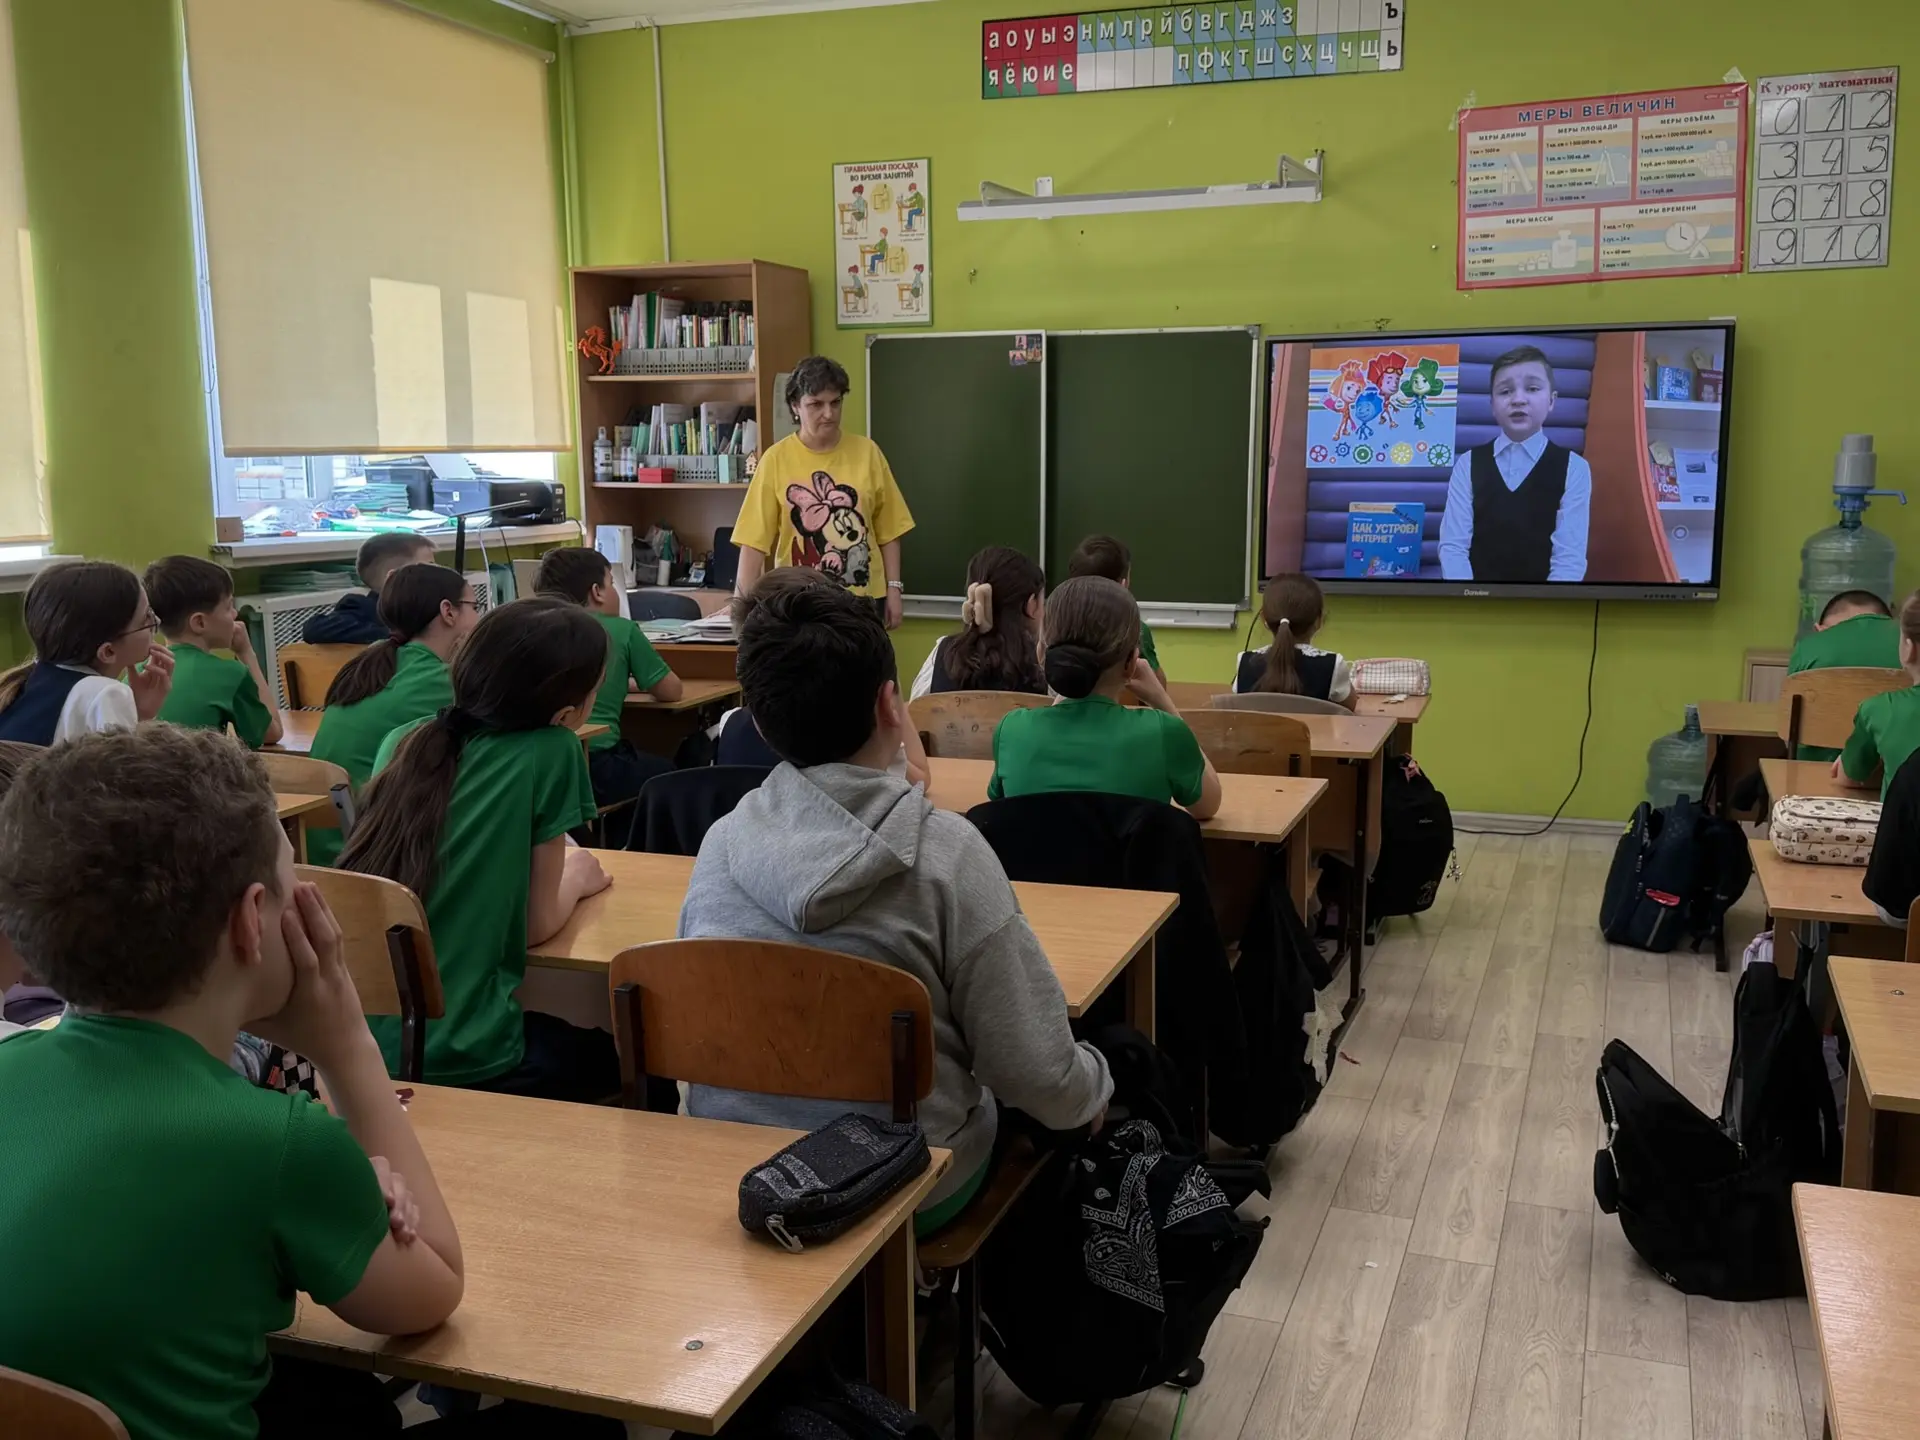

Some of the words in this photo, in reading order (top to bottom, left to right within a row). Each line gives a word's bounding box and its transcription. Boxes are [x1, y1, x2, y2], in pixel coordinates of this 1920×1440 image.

[1760, 82, 1772, 93] К
[1776, 82, 1814, 95] уроку
[1818, 76, 1893, 89] математики
[1518, 108, 1573, 122] МЕРЫ
[1582, 98, 1676, 116] ВЕЛИЧИН
[1775, 98, 1800, 135] 0
[1826, 94, 1845, 132] 1
[1867, 90, 1890, 128] 2
[1660, 117, 1682, 125] МЕРЫ
[1684, 114, 1715, 123] ОБЪЁМА
[1580, 123, 1618, 132] ПЛОЩАДИ
[1500, 132, 1527, 140] ДЛИНЫ
[1774, 142, 1798, 178] 3
[1822, 139, 1842, 174] 4
[1862, 136, 1887, 172] 5
[844, 164, 886, 173] ПРАВИЛЬНАЯ
[888, 162, 918, 170] ПОСАДКА
[883, 170, 914, 179] ЗАНЯТИЙ
[1772, 186, 1795, 221] 6
[1818, 182, 1840, 219] 7
[1860, 180, 1886, 216] 8
[1772, 228, 1796, 264] 9
[1824, 224, 1880, 262] 10
[1352, 523, 1372, 533] КАК
[1376, 524, 1418, 534] УСТРОЕН
[1352, 534, 1394, 543] ИНТЕРНЕТ
